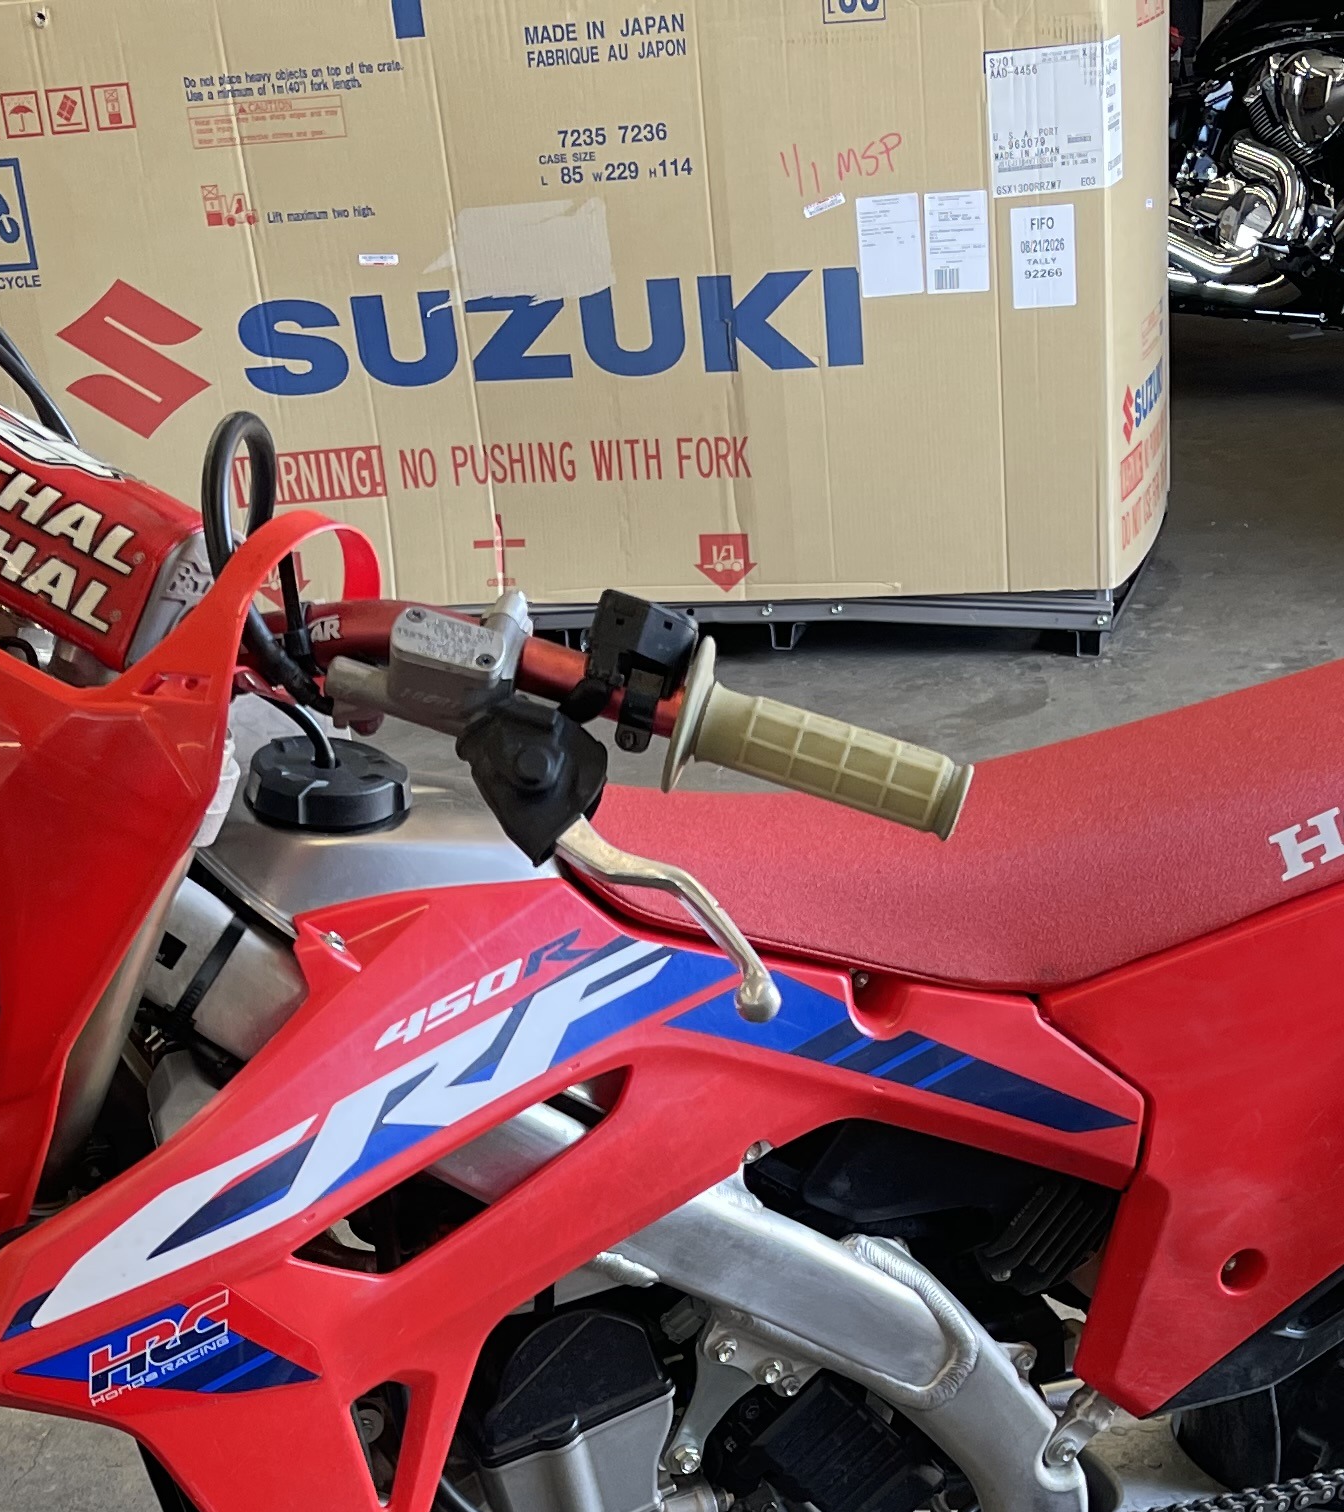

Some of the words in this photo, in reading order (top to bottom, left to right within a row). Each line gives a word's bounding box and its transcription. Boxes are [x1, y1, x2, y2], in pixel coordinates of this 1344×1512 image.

[524, 23, 577, 45] MADE
[586, 20, 605, 40] IN
[620, 13, 685, 37] JAPAN
[527, 46, 600, 68] FABRIQUE
[608, 44, 628, 62] AU
[638, 38, 686, 59] JAPON
[184, 77, 196, 88] Do
[200, 76, 214, 87] not
[245, 72, 271, 83] heavy
[276, 68, 307, 80] objects
[312, 68, 323, 77] on
[327, 66, 341, 76] top
[346, 62, 354, 75] of
[359, 62, 373, 74] the
[186, 90, 203, 101] Use
[208, 91, 213, 100] a
[258, 84, 266, 95] of
[311, 79, 328, 91] fork
[557, 127, 606, 148] 7235
[618, 122, 667, 144] 7236
[539, 153, 567, 165] CASE
[572, 151, 596, 162] SIZE
[837, 132, 902, 181] MSP
[994, 151, 1014, 161] MADE
[1035, 147, 1060, 157] JAPAN
[541, 176, 548, 186] L
[560, 166, 583, 184] 85
[267, 212, 283, 223] Lift
[332, 208, 349, 219] two
[1030, 217, 1055, 231] FIFO
[1027, 257, 1056, 265] TALLY
[237, 267, 864, 396] SUZUKI
[235, 448, 384, 505] WRNING!
[399, 447, 438, 489] NO
[451, 436, 576, 487] PUSHING
[590, 437, 661, 482] WITH
[677, 435, 752, 480] FORK
[374, 928, 600, 1051] 450R
[31, 938, 675, 1330] CRF
[89, 1289, 229, 1399] HRC
[91, 1372, 158, 1407] Honda
[161, 1335, 230, 1375] RACING
